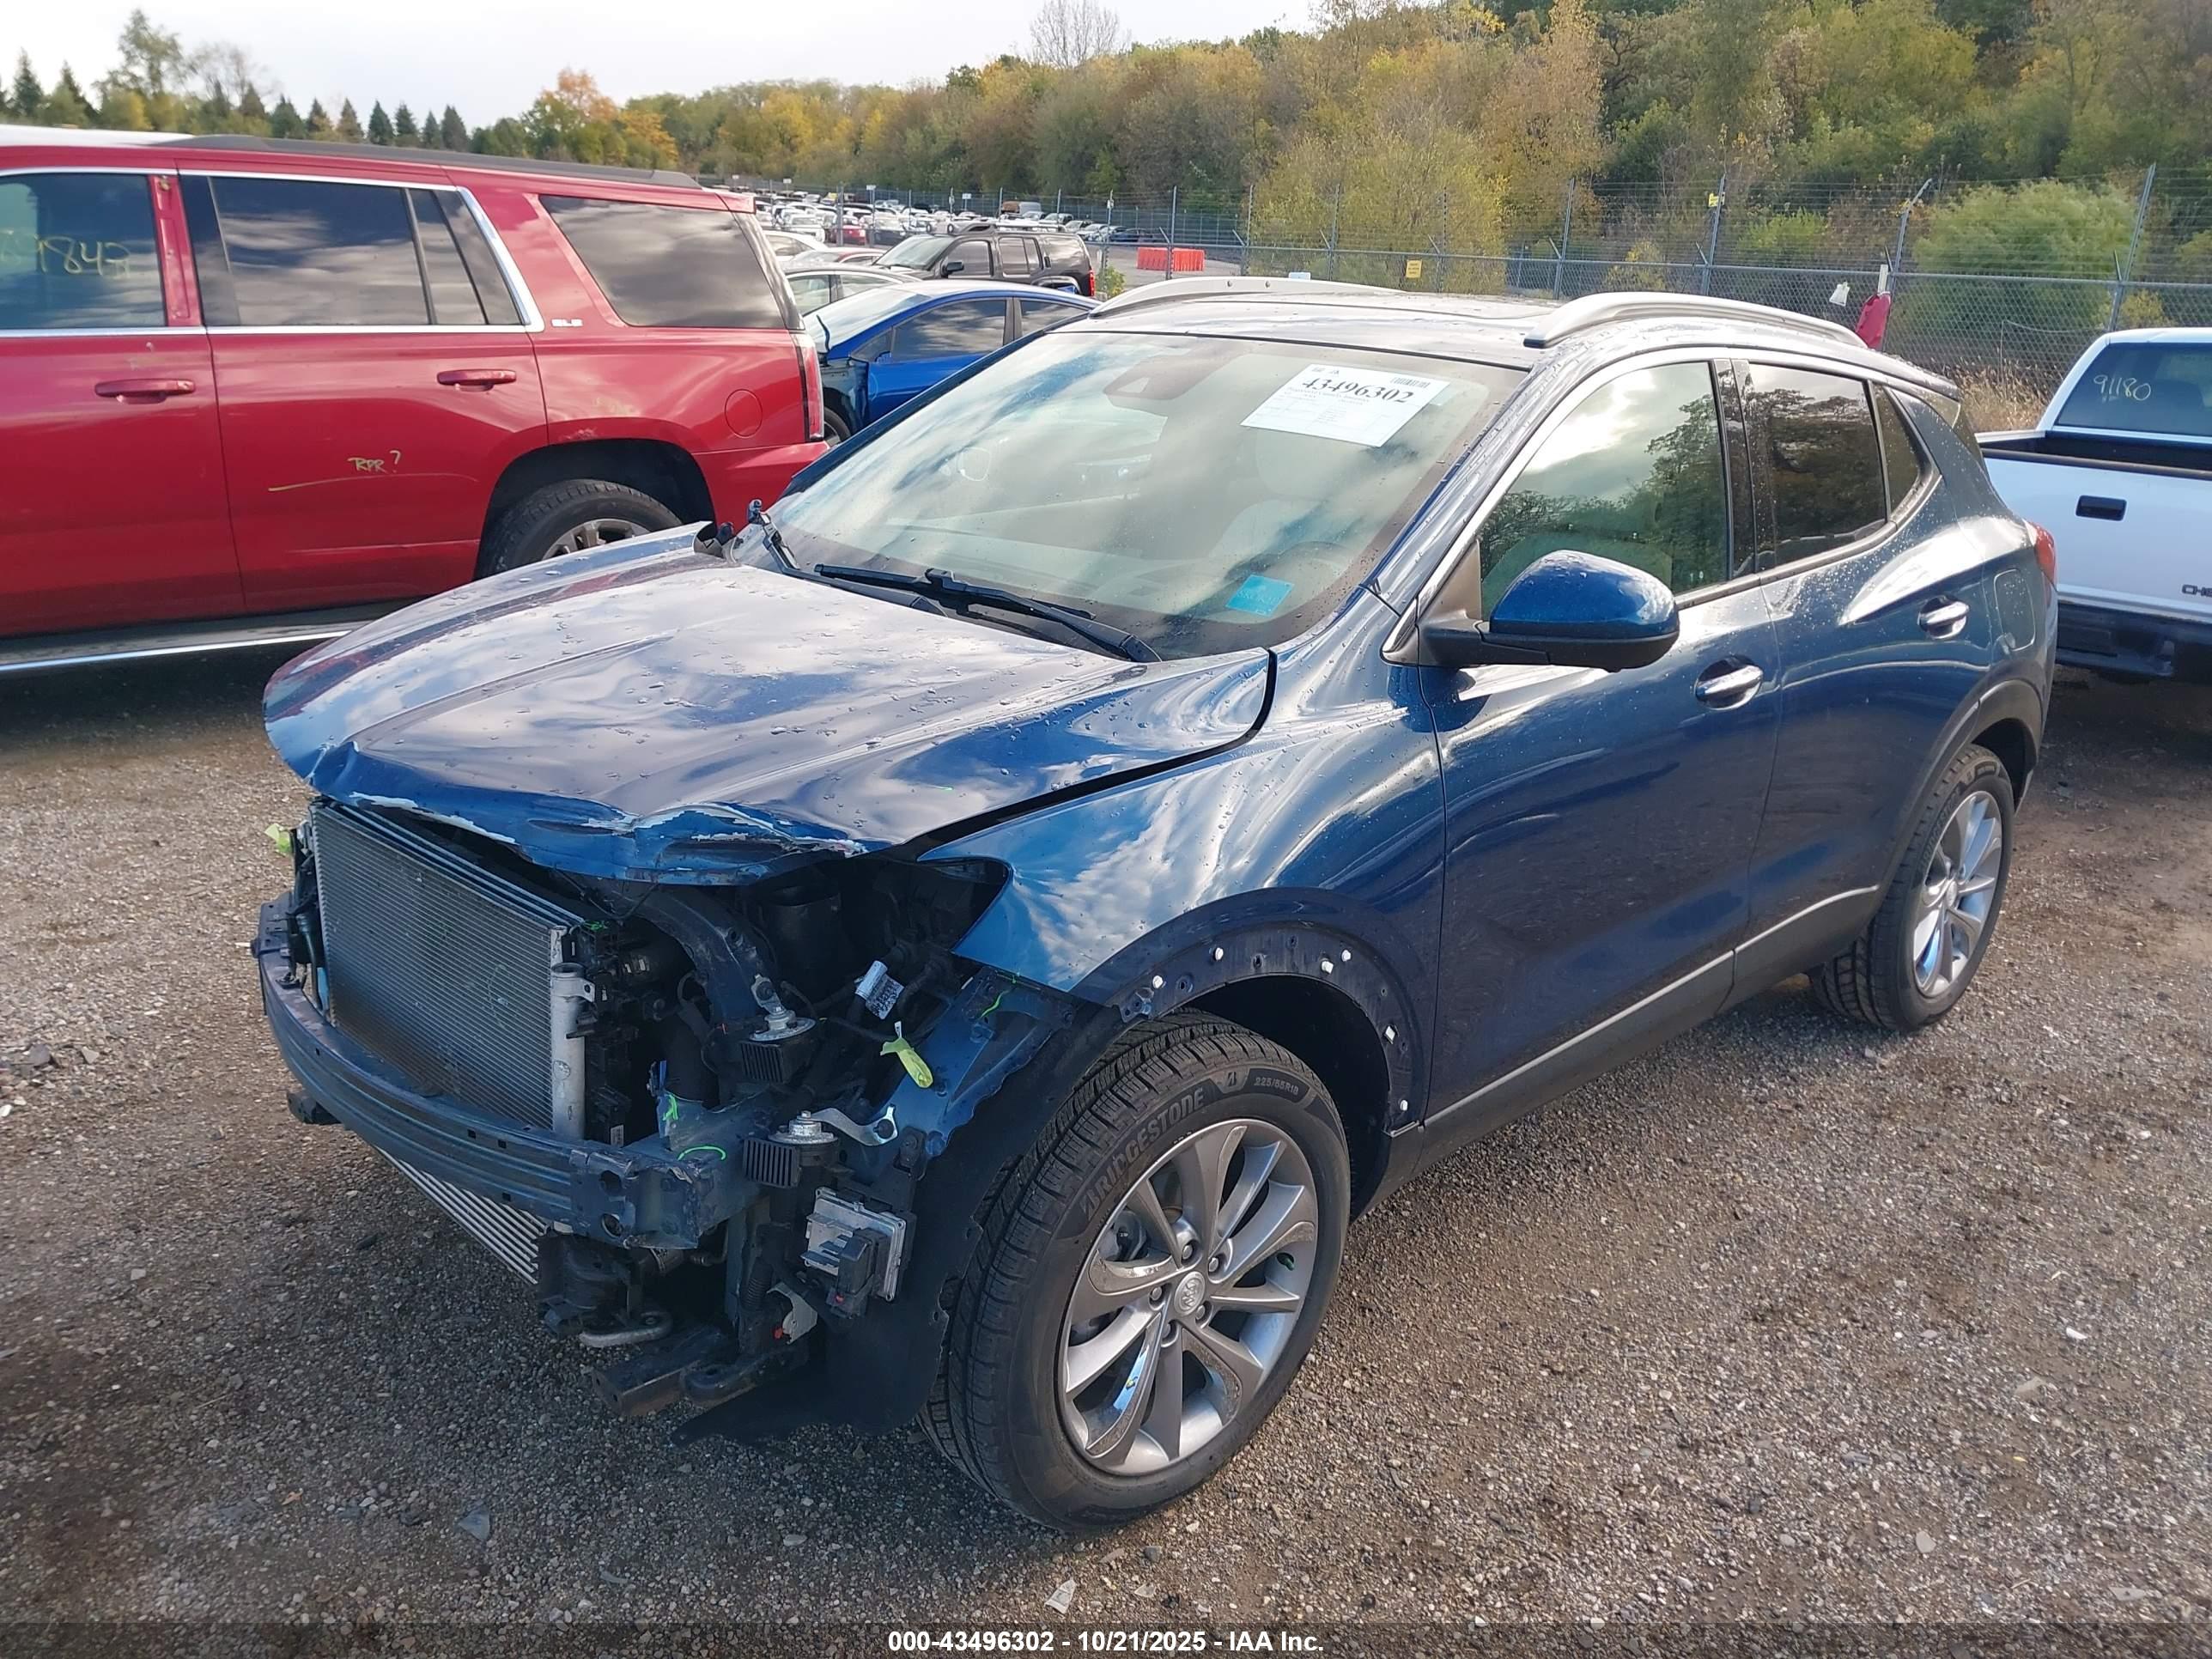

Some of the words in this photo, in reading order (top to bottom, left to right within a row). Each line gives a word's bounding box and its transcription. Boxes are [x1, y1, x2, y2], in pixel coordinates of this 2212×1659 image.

[1302, 377, 1415, 404] 43496302
[2094, 374, 2151, 401] 91180
[1079, 1087, 1206, 1221] BRIDGESTONE
